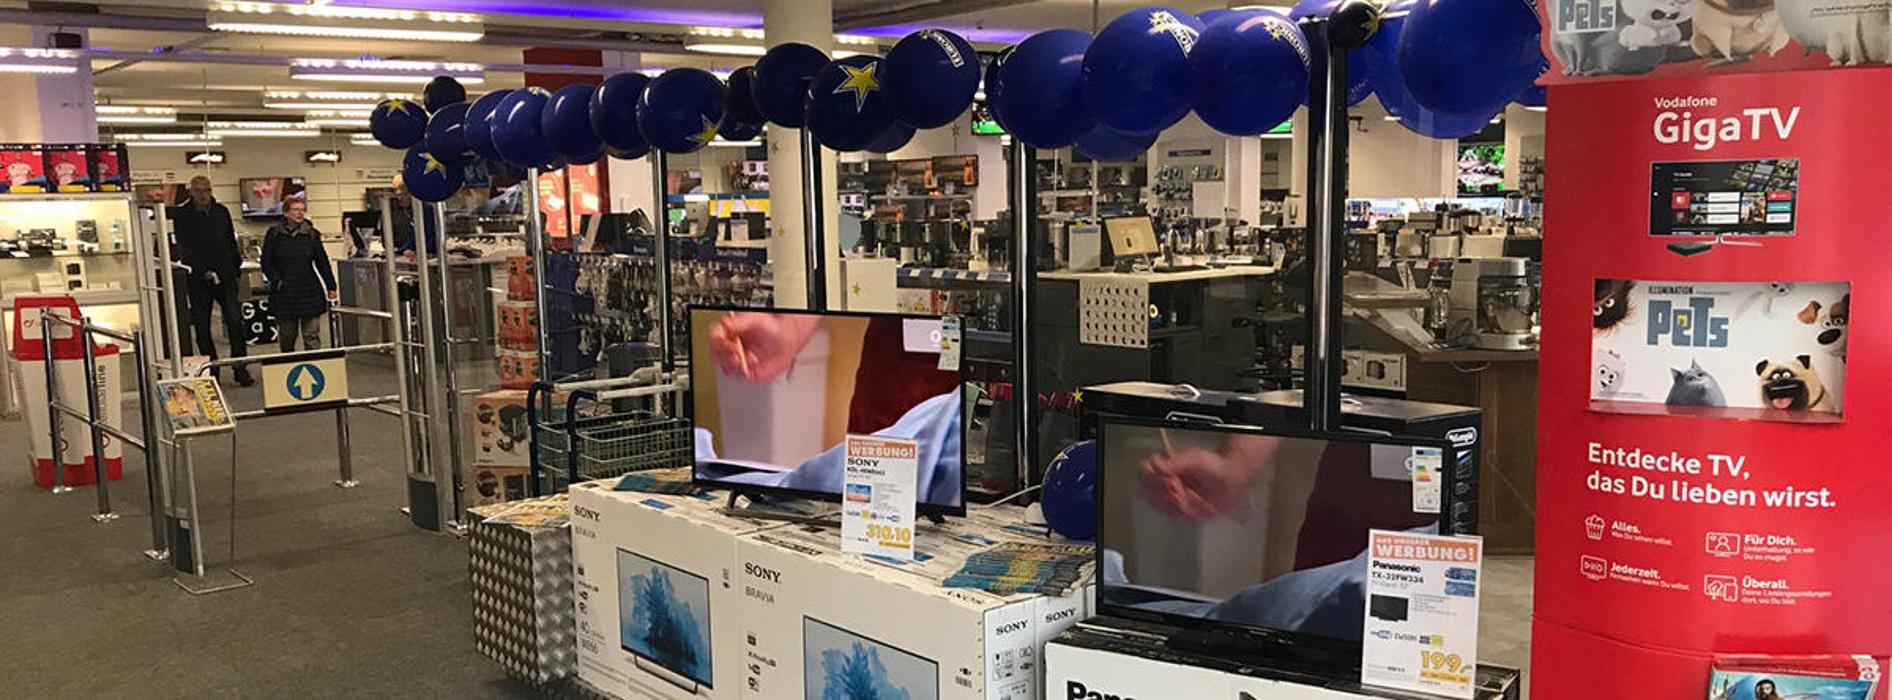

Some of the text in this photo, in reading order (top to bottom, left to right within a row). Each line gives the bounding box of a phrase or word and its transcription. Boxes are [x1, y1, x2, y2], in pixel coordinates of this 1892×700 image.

[1654, 95, 1718, 109] Vodafone
[1653, 106, 1801, 151] GigaTV
[850, 446, 914, 458] WERBUNG!
[1587, 442, 1750, 479] Entdecke TV,
[847, 456, 879, 467] SONY
[1586, 471, 1837, 508] das Du lieben wirst.
[574, 504, 601, 522] SONY
[1611, 520, 1641, 534] Alles.
[1744, 534, 1798, 546] Für Dich.
[1376, 543, 1474, 561] WERBUNG!
[745, 562, 782, 583] SONY
[1372, 560, 1422, 573] Panasonic
[1610, 562, 1662, 580] Jederzeit.
[1742, 575, 1790, 590] Überall.
[745, 585, 775, 605] BRAVIA
[1046, 608, 1076, 624] SONY
[995, 619, 1028, 636] SONY
